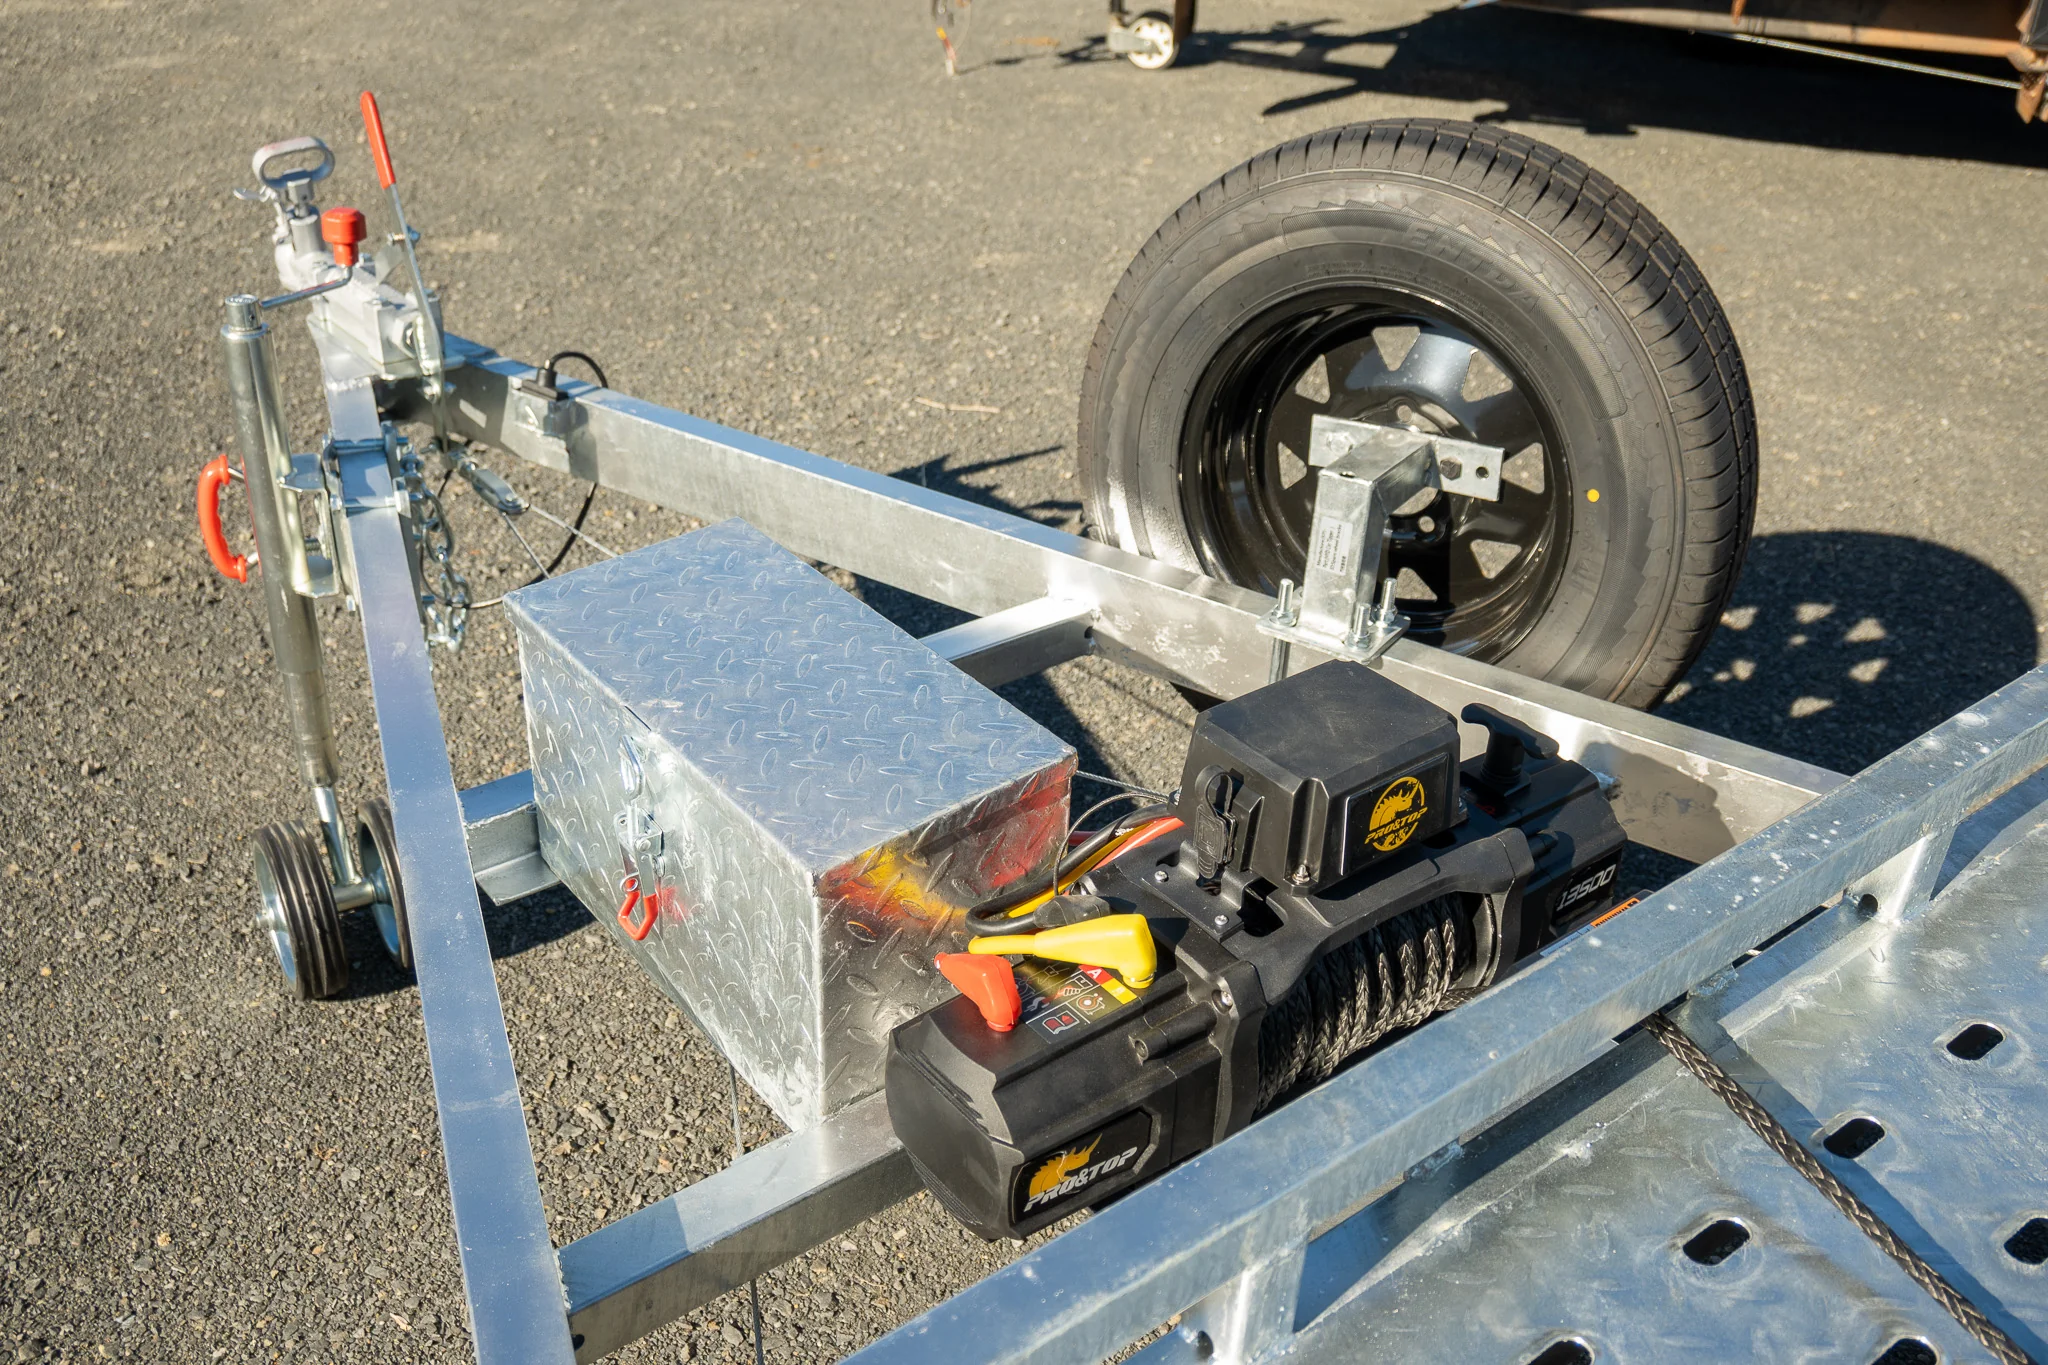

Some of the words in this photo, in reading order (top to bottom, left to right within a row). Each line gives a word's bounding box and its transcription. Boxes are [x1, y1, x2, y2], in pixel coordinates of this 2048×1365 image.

[1364, 806, 1428, 845] PRO&TOP
[1556, 864, 1616, 912] 13500
[1023, 1147, 1138, 1213] PRO&TOP
